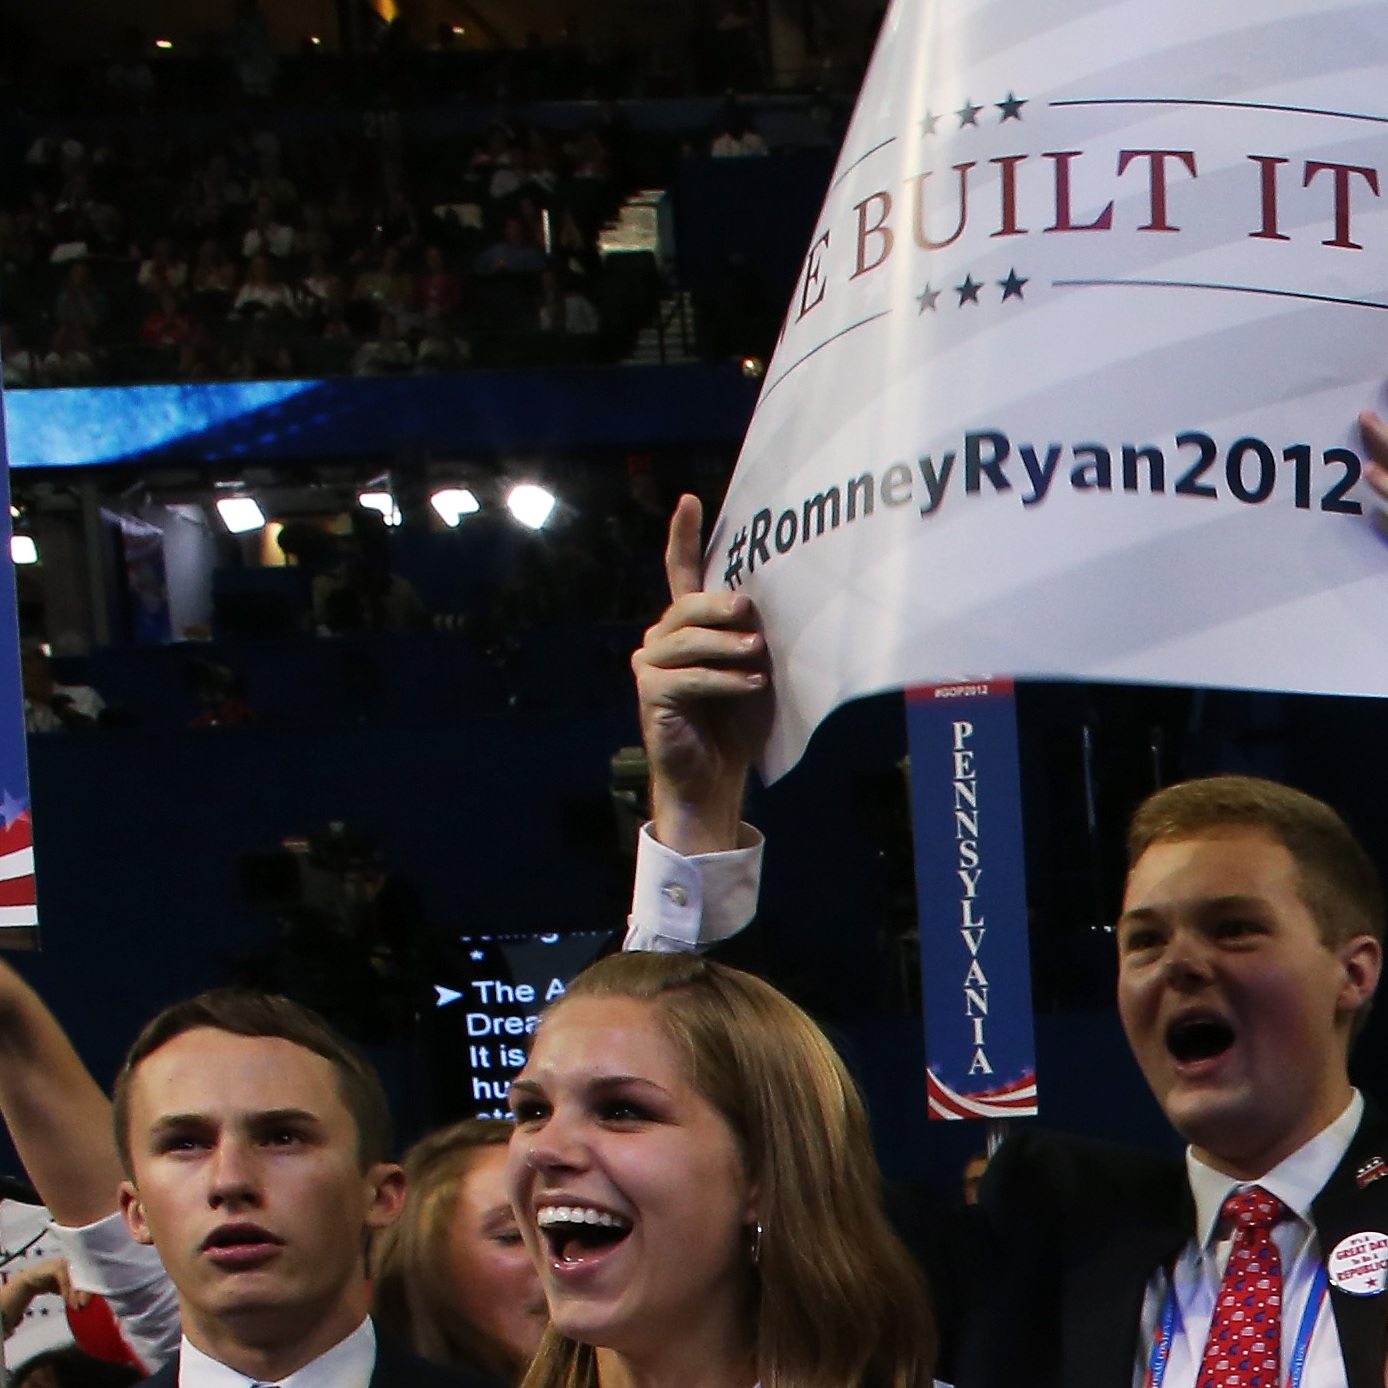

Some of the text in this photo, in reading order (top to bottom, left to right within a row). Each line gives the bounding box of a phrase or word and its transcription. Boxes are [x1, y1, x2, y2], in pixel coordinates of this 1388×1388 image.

[852, 149, 1199, 280] BUILT
[1248, 156, 1381, 250] IT
[723, 430, 1365, 591] #RomneyRyan2012
[952, 720, 993, 1076] PENNSYLVANIA
[471, 980, 535, 1004] The
[469, 1044, 527, 1068] It is
[1337, 1239, 1388, 1260] GREAT DAY
